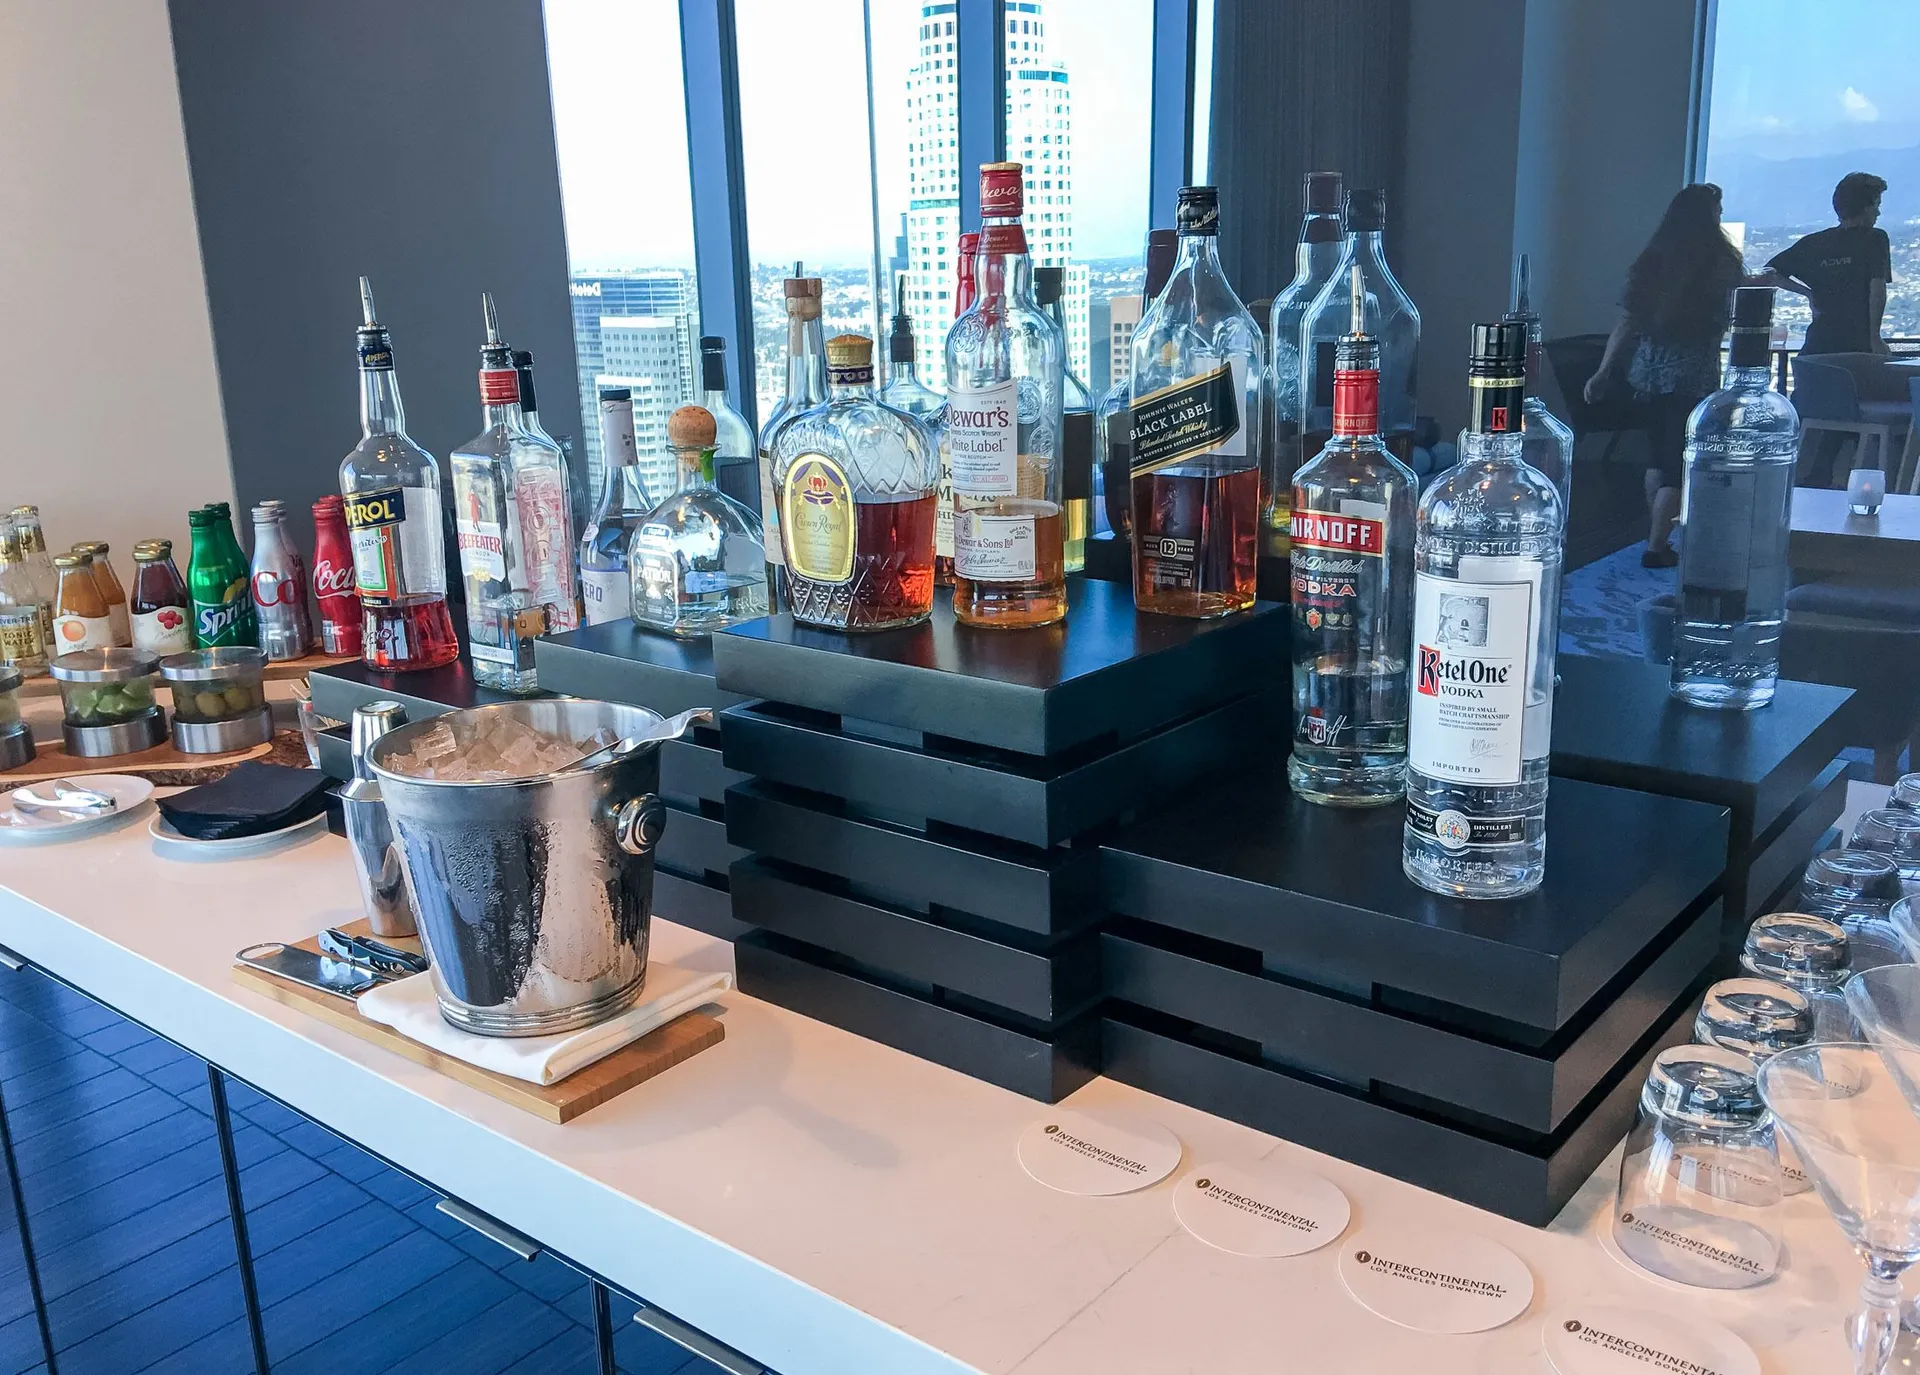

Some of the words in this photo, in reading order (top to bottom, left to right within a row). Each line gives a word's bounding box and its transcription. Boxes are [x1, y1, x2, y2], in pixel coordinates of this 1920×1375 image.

[1129, 417, 1169, 441] BLACK
[1171, 401, 1213, 425] LABEL
[1494, 409, 1506, 428] K
[343, 499, 396, 526] PEROL
[1289, 516, 1372, 546] MIRNOFF
[1163, 542, 1174, 554] 12
[584, 581, 603, 603] ERO
[1419, 649, 1466, 694] Ketel
[1468, 660, 1508, 684] One
[1440, 685, 1484, 699] VODKA
[1432, 760, 1481, 773] IMPORTED
[1050, 1136, 1063, 1145] LOS
[1064, 1143, 1096, 1159] ANGELES
[1097, 1157, 1141, 1175] DOWNTOWN
[1056, 1131, 1147, 1173] INTERCONTINENTAL
[1204, 1190, 1220, 1200] LOS
[1222, 1198, 1258, 1215] ANGELES
[1260, 1213, 1312, 1233] DOWNTOWN
[1209, 1184, 1319, 1229] INTERCONTINENTAL
[1630, 1225, 1647, 1235] LOS
[1650, 1231, 1694, 1252] ANGELES
[1696, 1250, 1758, 1275] DOWNTOWN
[1634, 1219, 1764, 1273] INTERCONTINENTAL
[1370, 1265, 1388, 1274] LOS
[1392, 1271, 1436, 1286] ANGELES
[1440, 1282, 1502, 1298] DOWNTOWN
[1373, 1257, 1507, 1294] INTERCONTINENTAL
[1578, 1335, 1598, 1345] LOS
[1601, 1343, 1650, 1363] ANGELES
[1654, 1360, 1696, 1375] DOWN
[1583, 1326, 1723, 1375] INTERCONTINENTA
